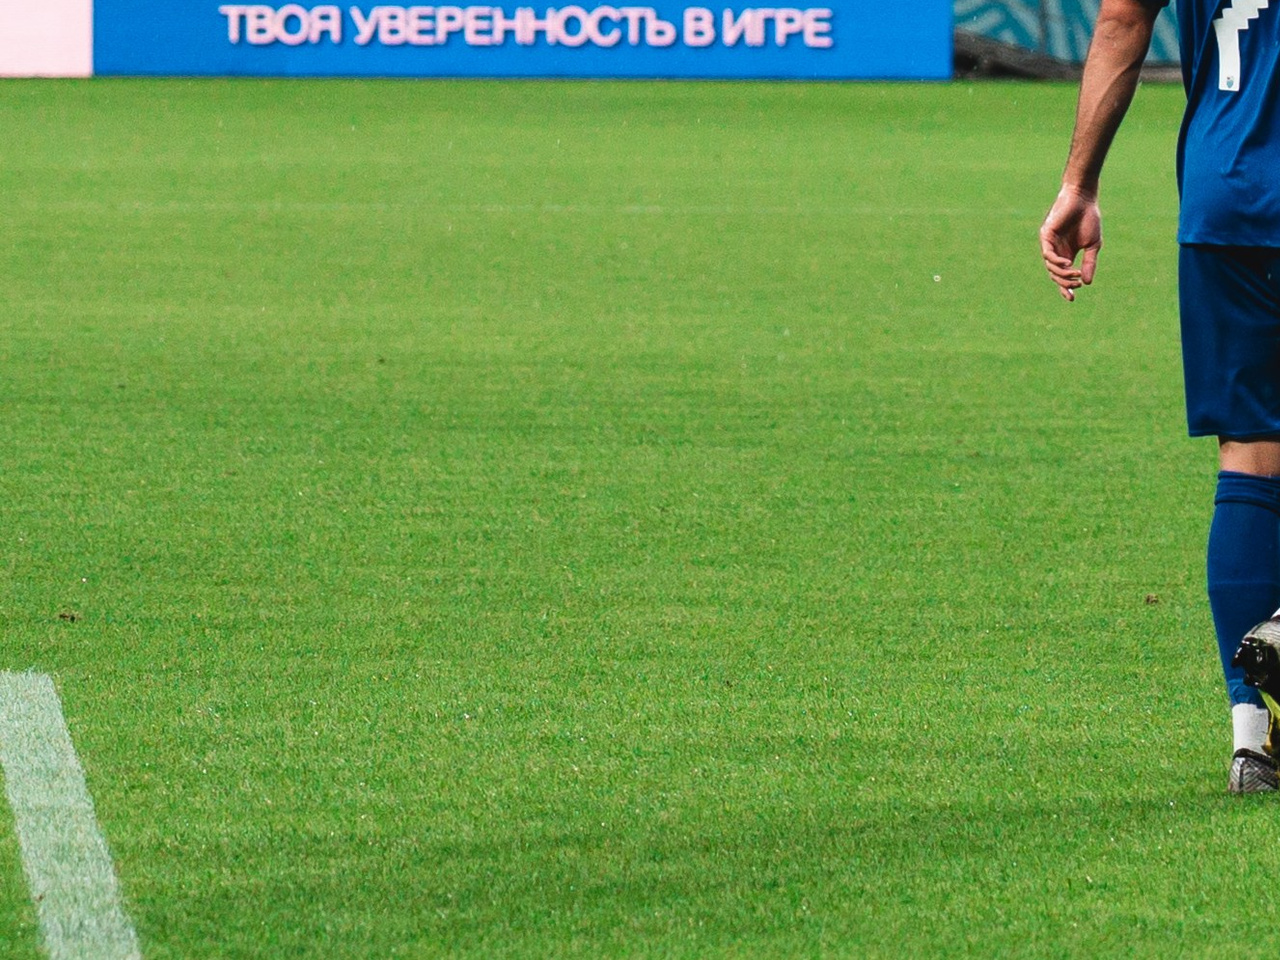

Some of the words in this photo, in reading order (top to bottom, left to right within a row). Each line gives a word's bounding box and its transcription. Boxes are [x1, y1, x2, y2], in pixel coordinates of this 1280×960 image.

[218, 3, 342, 46] ТВОЯ
[349, 4, 677, 47] УВЕРЕННОСТЬ
[683, 6, 716, 47] В
[722, 7, 834, 48] ИГРЕ
